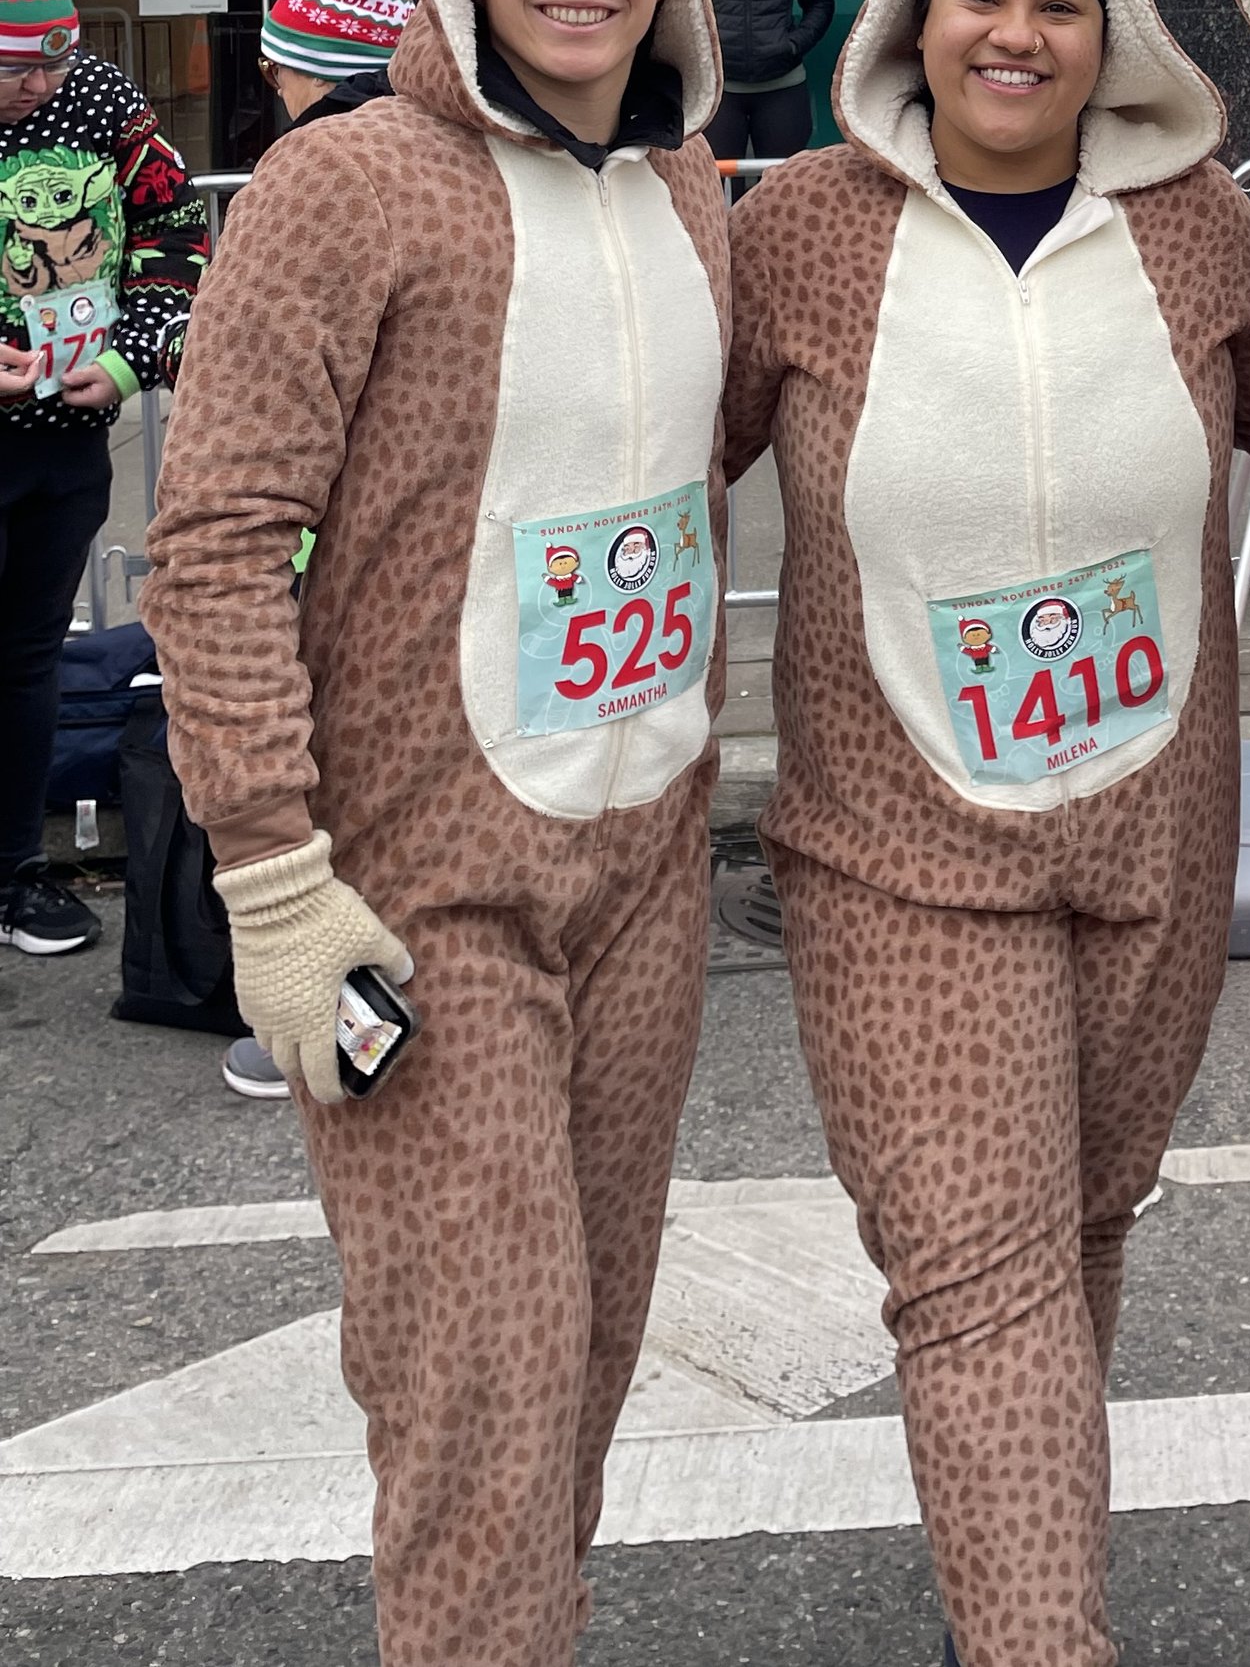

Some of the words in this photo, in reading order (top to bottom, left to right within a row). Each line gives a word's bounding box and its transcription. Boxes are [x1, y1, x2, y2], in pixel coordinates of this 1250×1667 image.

[540, 522, 589, 537] SUNDAY
[593, 508, 649, 528] NOVEMBER
[952, 597, 997, 611] SUNDAY
[1001, 581, 1064, 603] NOVEMBER
[1100, 559, 1127, 573] 2024
[554, 581, 692, 701] 525
[597, 682, 668, 719] SAMANTHA
[957, 635, 1165, 761] 1410
[1047, 736, 1099, 770] MILENA
